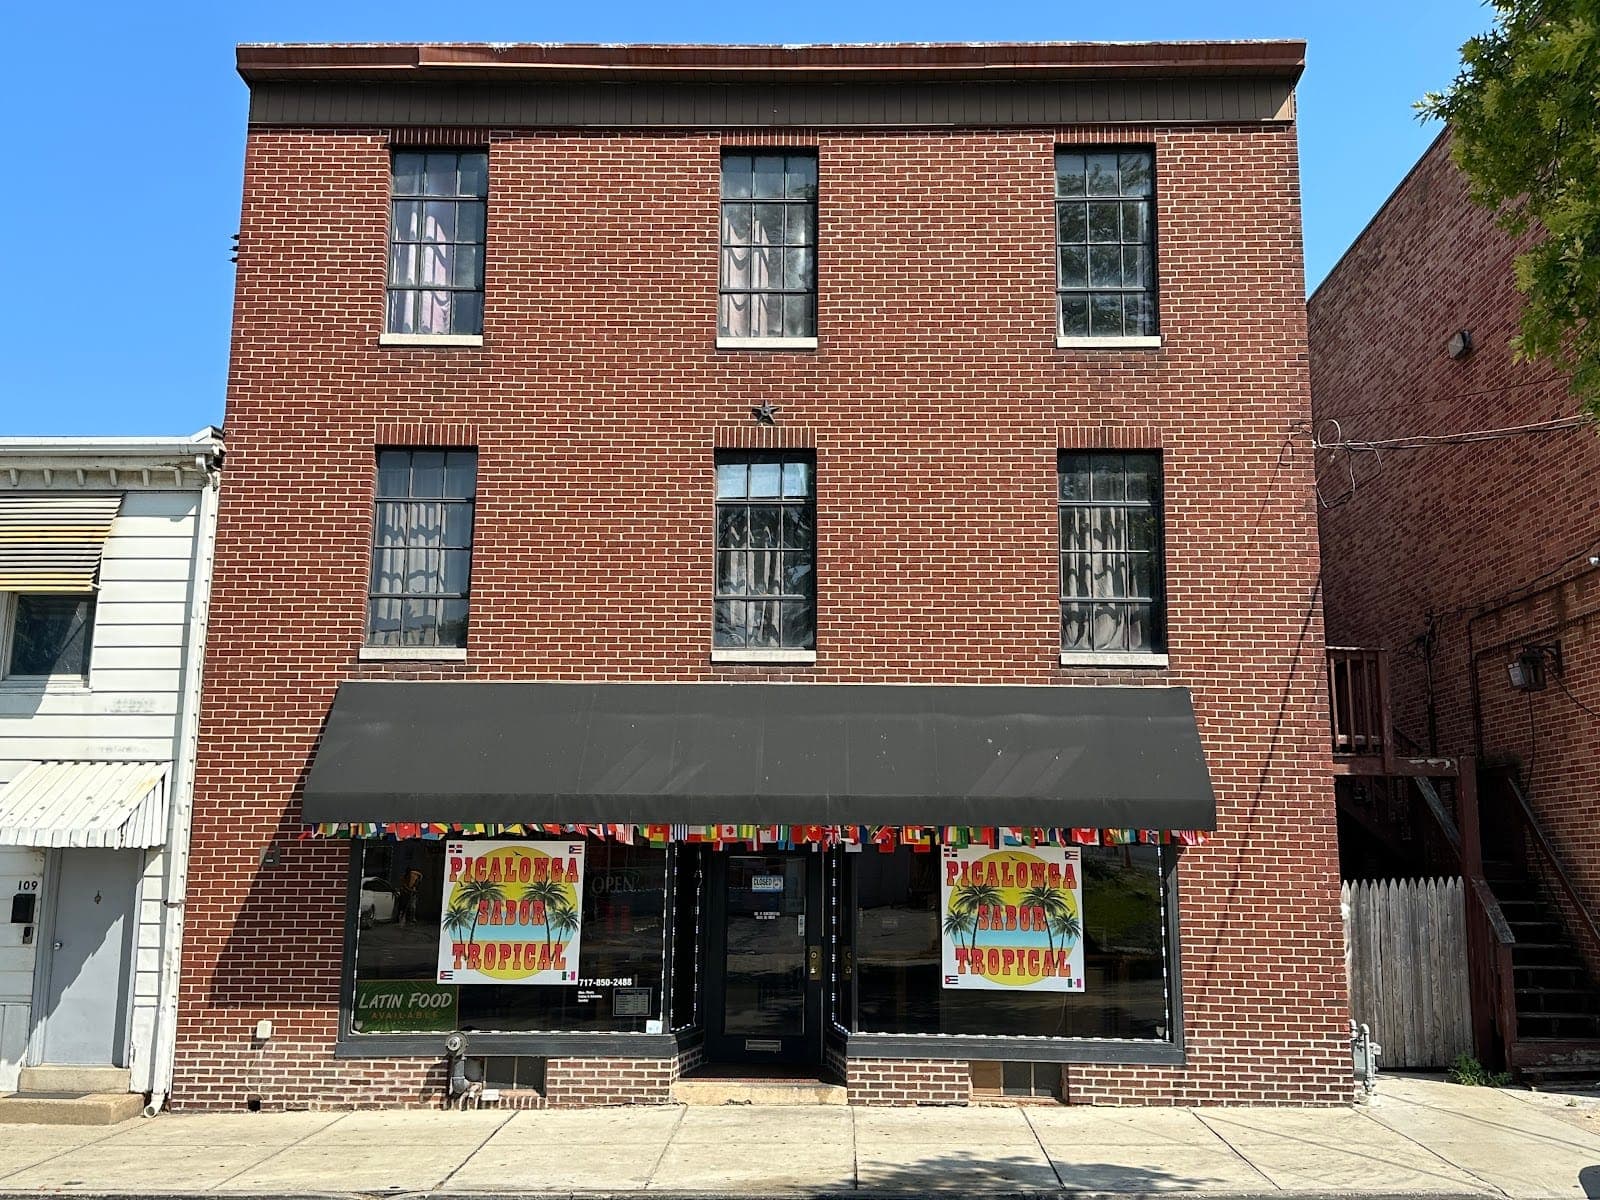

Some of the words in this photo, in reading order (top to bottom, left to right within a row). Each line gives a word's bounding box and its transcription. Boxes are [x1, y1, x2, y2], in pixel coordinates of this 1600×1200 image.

[449, 856, 579, 883] PICALONGA
[946, 860, 1077, 889] PICALONGA
[18, 880, 38, 891] 109
[477, 899, 546, 926] SABOR
[978, 904, 1048, 932] SABOR
[452, 943, 567, 970] TROPICAL
[955, 948, 1071, 977] TROPICAL
[579, 978, 632, 987] 717-850-2488
[359, 993, 403, 1009] LATIN
[408, 992, 452, 1009] FOOD
[371, 1010, 438, 1020] AVAILABLE
